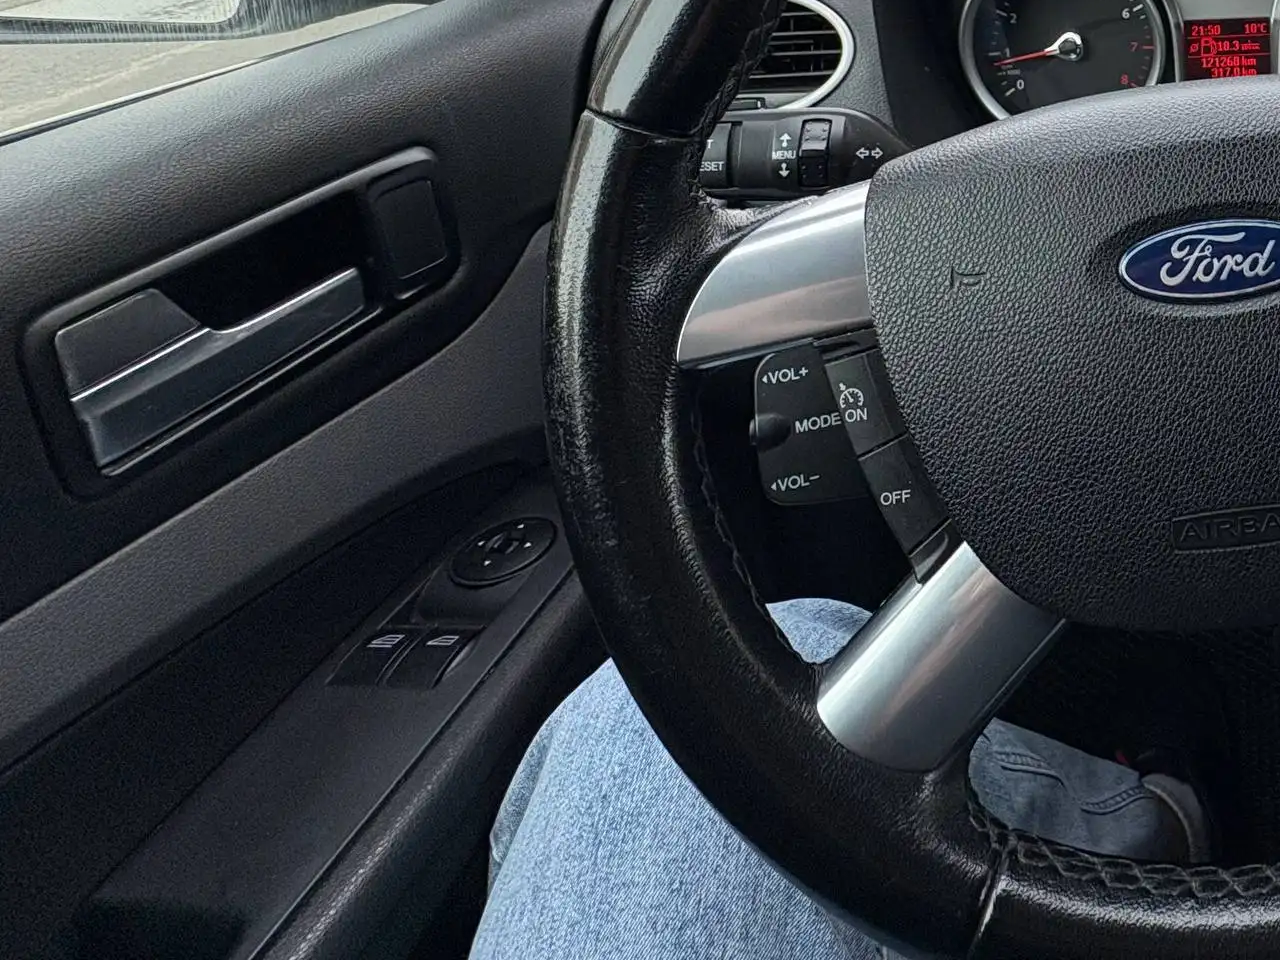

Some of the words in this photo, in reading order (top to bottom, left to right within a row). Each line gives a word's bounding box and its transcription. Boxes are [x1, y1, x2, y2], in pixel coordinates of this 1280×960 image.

[1009, 13, 1017, 24] 2
[1121, 8, 1130, 19] 6
[1191, 24, 1221, 36] 21:50
[1130, 42, 1138, 52] 7
[1242, 56, 1257, 66] km
[1016, 80, 1025, 90] 0
[1121, 74, 1128, 85] 8
[772, 150, 797, 160] MENU
[700, 161, 725, 171] ESET
[1159, 231, 1276, 287] Ford
[845, 407, 868, 423] ON
[795, 412, 842, 434] MODE
[880, 489, 911, 506] OFF
